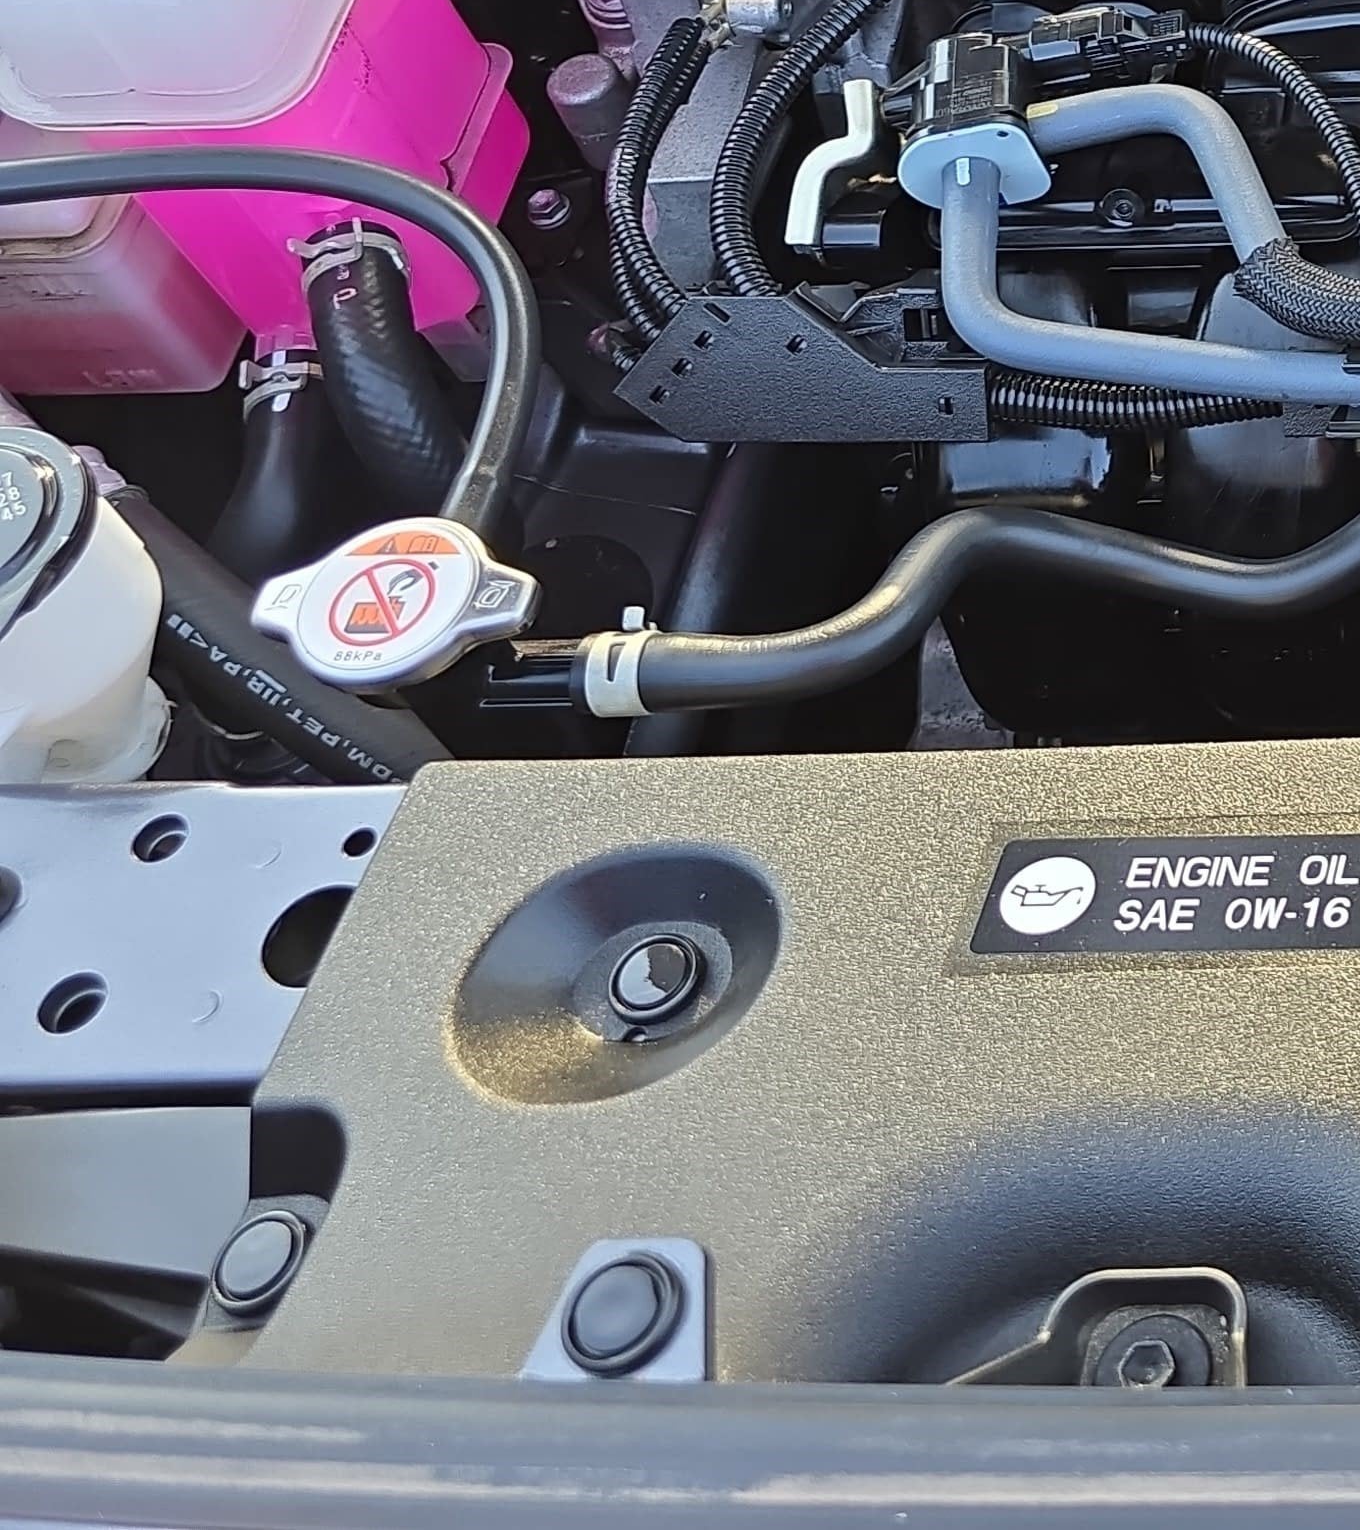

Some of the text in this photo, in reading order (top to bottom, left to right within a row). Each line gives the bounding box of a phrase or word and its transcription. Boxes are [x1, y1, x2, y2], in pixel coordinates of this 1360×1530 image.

[333, 650, 383, 662] 88kPa
[1125, 854, 1359, 888] ENGINE OIL
[1113, 897, 1353, 932] SAE 0W-16
